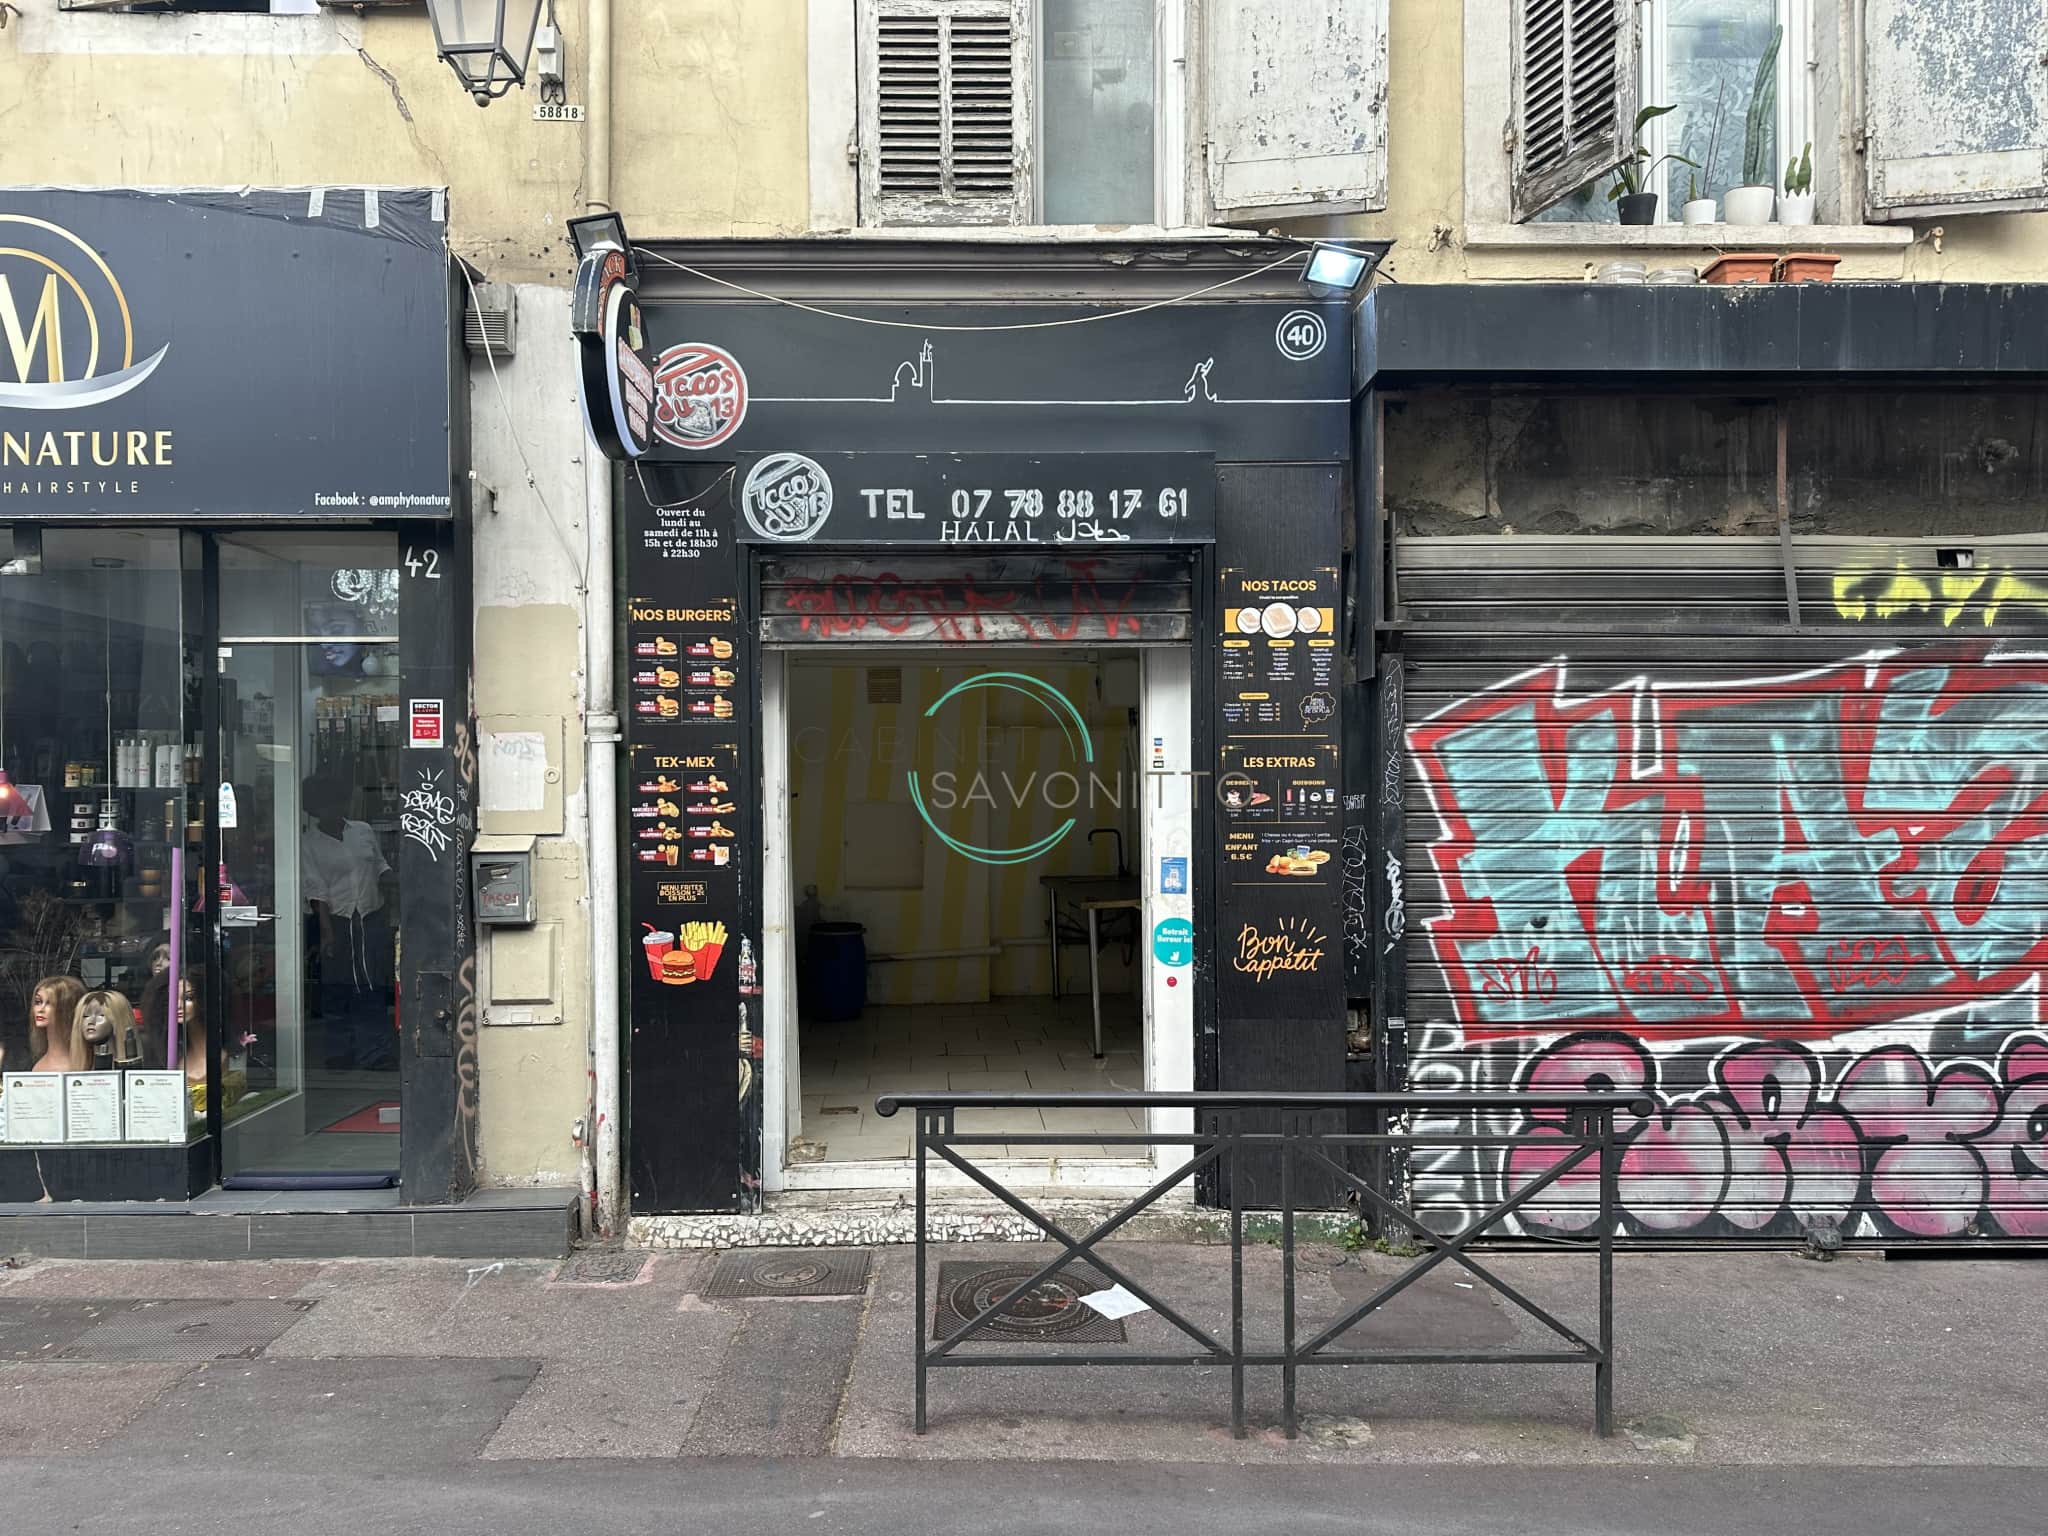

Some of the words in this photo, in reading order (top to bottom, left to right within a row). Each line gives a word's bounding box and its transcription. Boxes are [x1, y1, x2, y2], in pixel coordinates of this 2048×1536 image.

[540, 107, 578, 118] 58818
[1287, 325, 1314, 346] 40
[709, 397, 737, 420] 13
[3, 430, 173, 467] NATURE
[3, 481, 139, 494] HAIRSTYLE
[315, 491, 359, 506] Facebook
[369, 491, 450, 508] @amphytonature
[860, 489, 925, 518] TEL
[952, 489, 992, 518] 07
[1004, 488, 1044, 518] 78
[1056, 489, 1094, 518] 88
[1109, 489, 1142, 519] 17
[1158, 488, 1188, 517] 61
[656, 508, 690, 517] Ouvert
[693, 508, 705, 517] du
[661, 518, 686, 527] lundi
[644, 528, 678, 537] samedi
[681, 528, 693, 537] de
[695, 528, 710, 537] 11h
[712, 528, 718, 537] à
[939, 521, 1039, 541] HALAL
[645, 539, 660, 547] 15h
[675, 539, 687, 547] de
[690, 539, 718, 547] 18h30
[662, 549, 668, 557] à
[671, 549, 700, 558] 22h30
[404, 545, 440, 578] 42
[1241, 580, 1269, 592] NOS
[1272, 580, 1317, 591] TACOS
[633, 609, 664, 621] NOS
[667, 609, 731, 621] BURGERS
[654, 757, 716, 768] TEX-MEX
[1243, 757, 1264, 768] LES
[1266, 757, 1316, 768] EXTRAS
[1229, 832, 1254, 840] MENU
[1237, 923, 1296, 959] Bon
[1233, 948, 1325, 983] appétit
